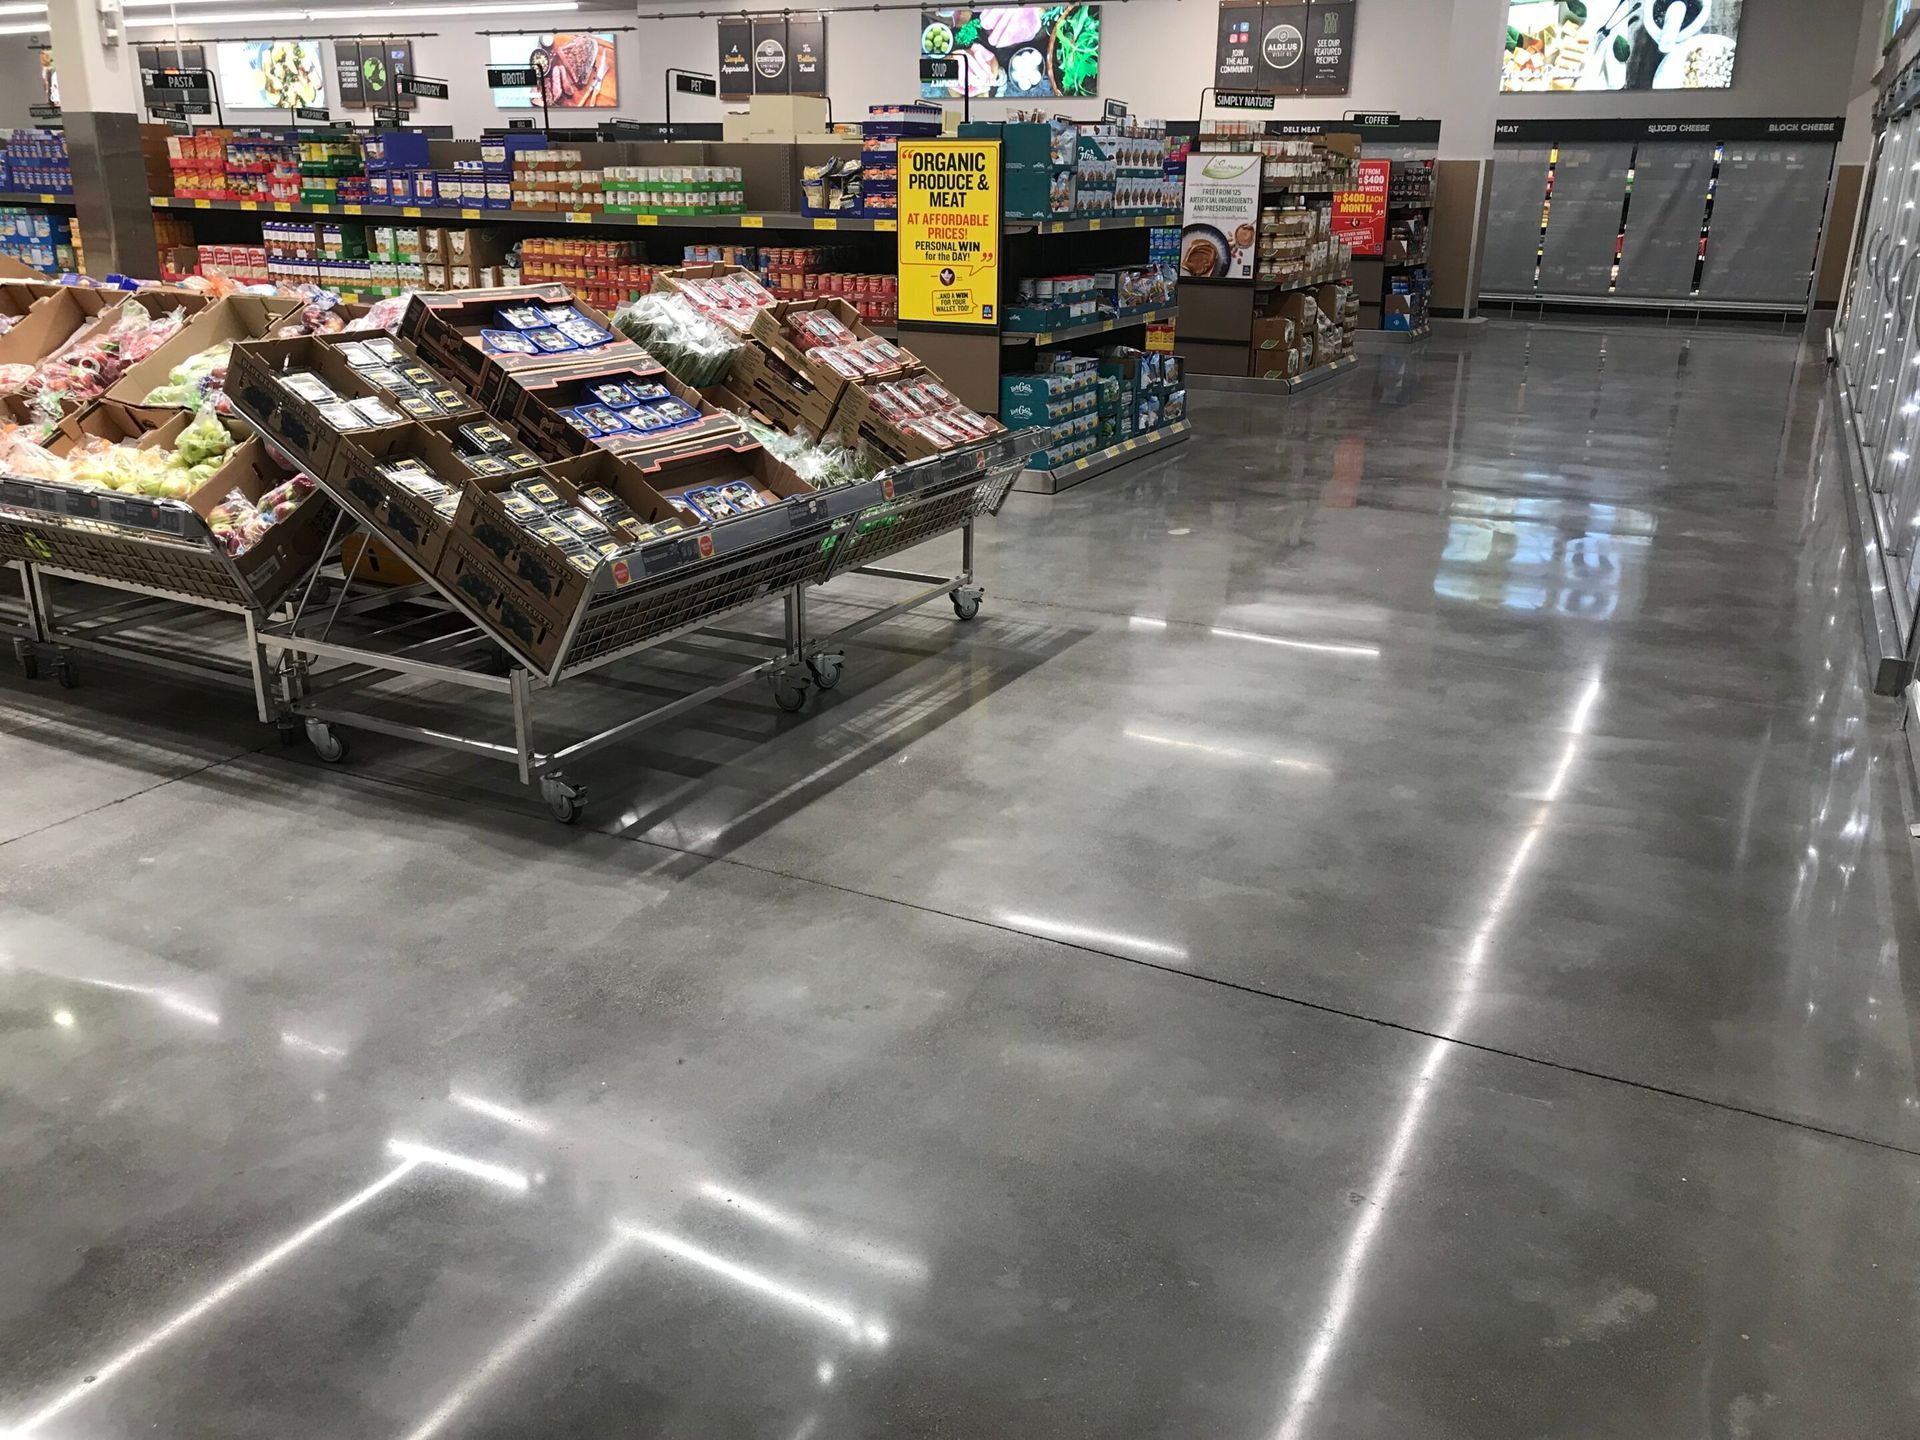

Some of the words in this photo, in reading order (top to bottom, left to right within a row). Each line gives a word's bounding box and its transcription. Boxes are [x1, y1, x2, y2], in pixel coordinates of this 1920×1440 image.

[1267, 43, 1297, 51] ALDI.US
[1314, 47, 1342, 56] FEATURED
[1231, 49, 1244, 57] JOIN
[1316, 56, 1338, 64] RECIPES
[721, 64, 750, 74] Approach
[800, 64, 815, 72] Food
[932, 63, 947, 77] SOUP
[1220, 65, 1254, 73] COMMUNITY
[168, 76, 195, 88] PASTA
[502, 72, 525, 85] BROTH
[409, 82, 440, 97] LAUNDRY
[691, 80, 702, 92] PET
[1217, 95, 1242, 106] SIMPLY
[1244, 96, 1273, 107] NATURE
[1365, 116, 1389, 125] COFFEE
[1648, 125, 1677, 133] SLICED
[1679, 124, 1710, 132] CHEESE
[1769, 124, 1798, 132] BLOCK
[1801, 123, 1834, 131] CHEESE
[909, 174, 973, 190] PRODUCE
[977, 174, 989, 190] &
[1364, 176, 1384, 184] $400
[929, 192, 967, 208] MEAT
[1343, 193, 1365, 203] $400
[1340, 204, 1374, 213] MONTH.
[907, 213, 919, 225] AT
[922, 213, 989, 226] AFFORDABLE
[928, 227, 968, 240] PRICES!
[915, 241, 957, 251] PERSONAL
[958, 242, 980, 252] WIN
[925, 251, 936, 260] for
[938, 252, 950, 260] the
[952, 252, 970, 261] DAY!
[345, 448, 399, 498] BLUEBERRIES
[404, 497, 440, 532] BLEUETS
[473, 493, 529, 549] BLUEBERRIES
[532, 546, 574, 581] BLEUETS
[457, 543, 511, 597] BLUEBERRIES
[515, 595, 554, 631] BLEUETS
